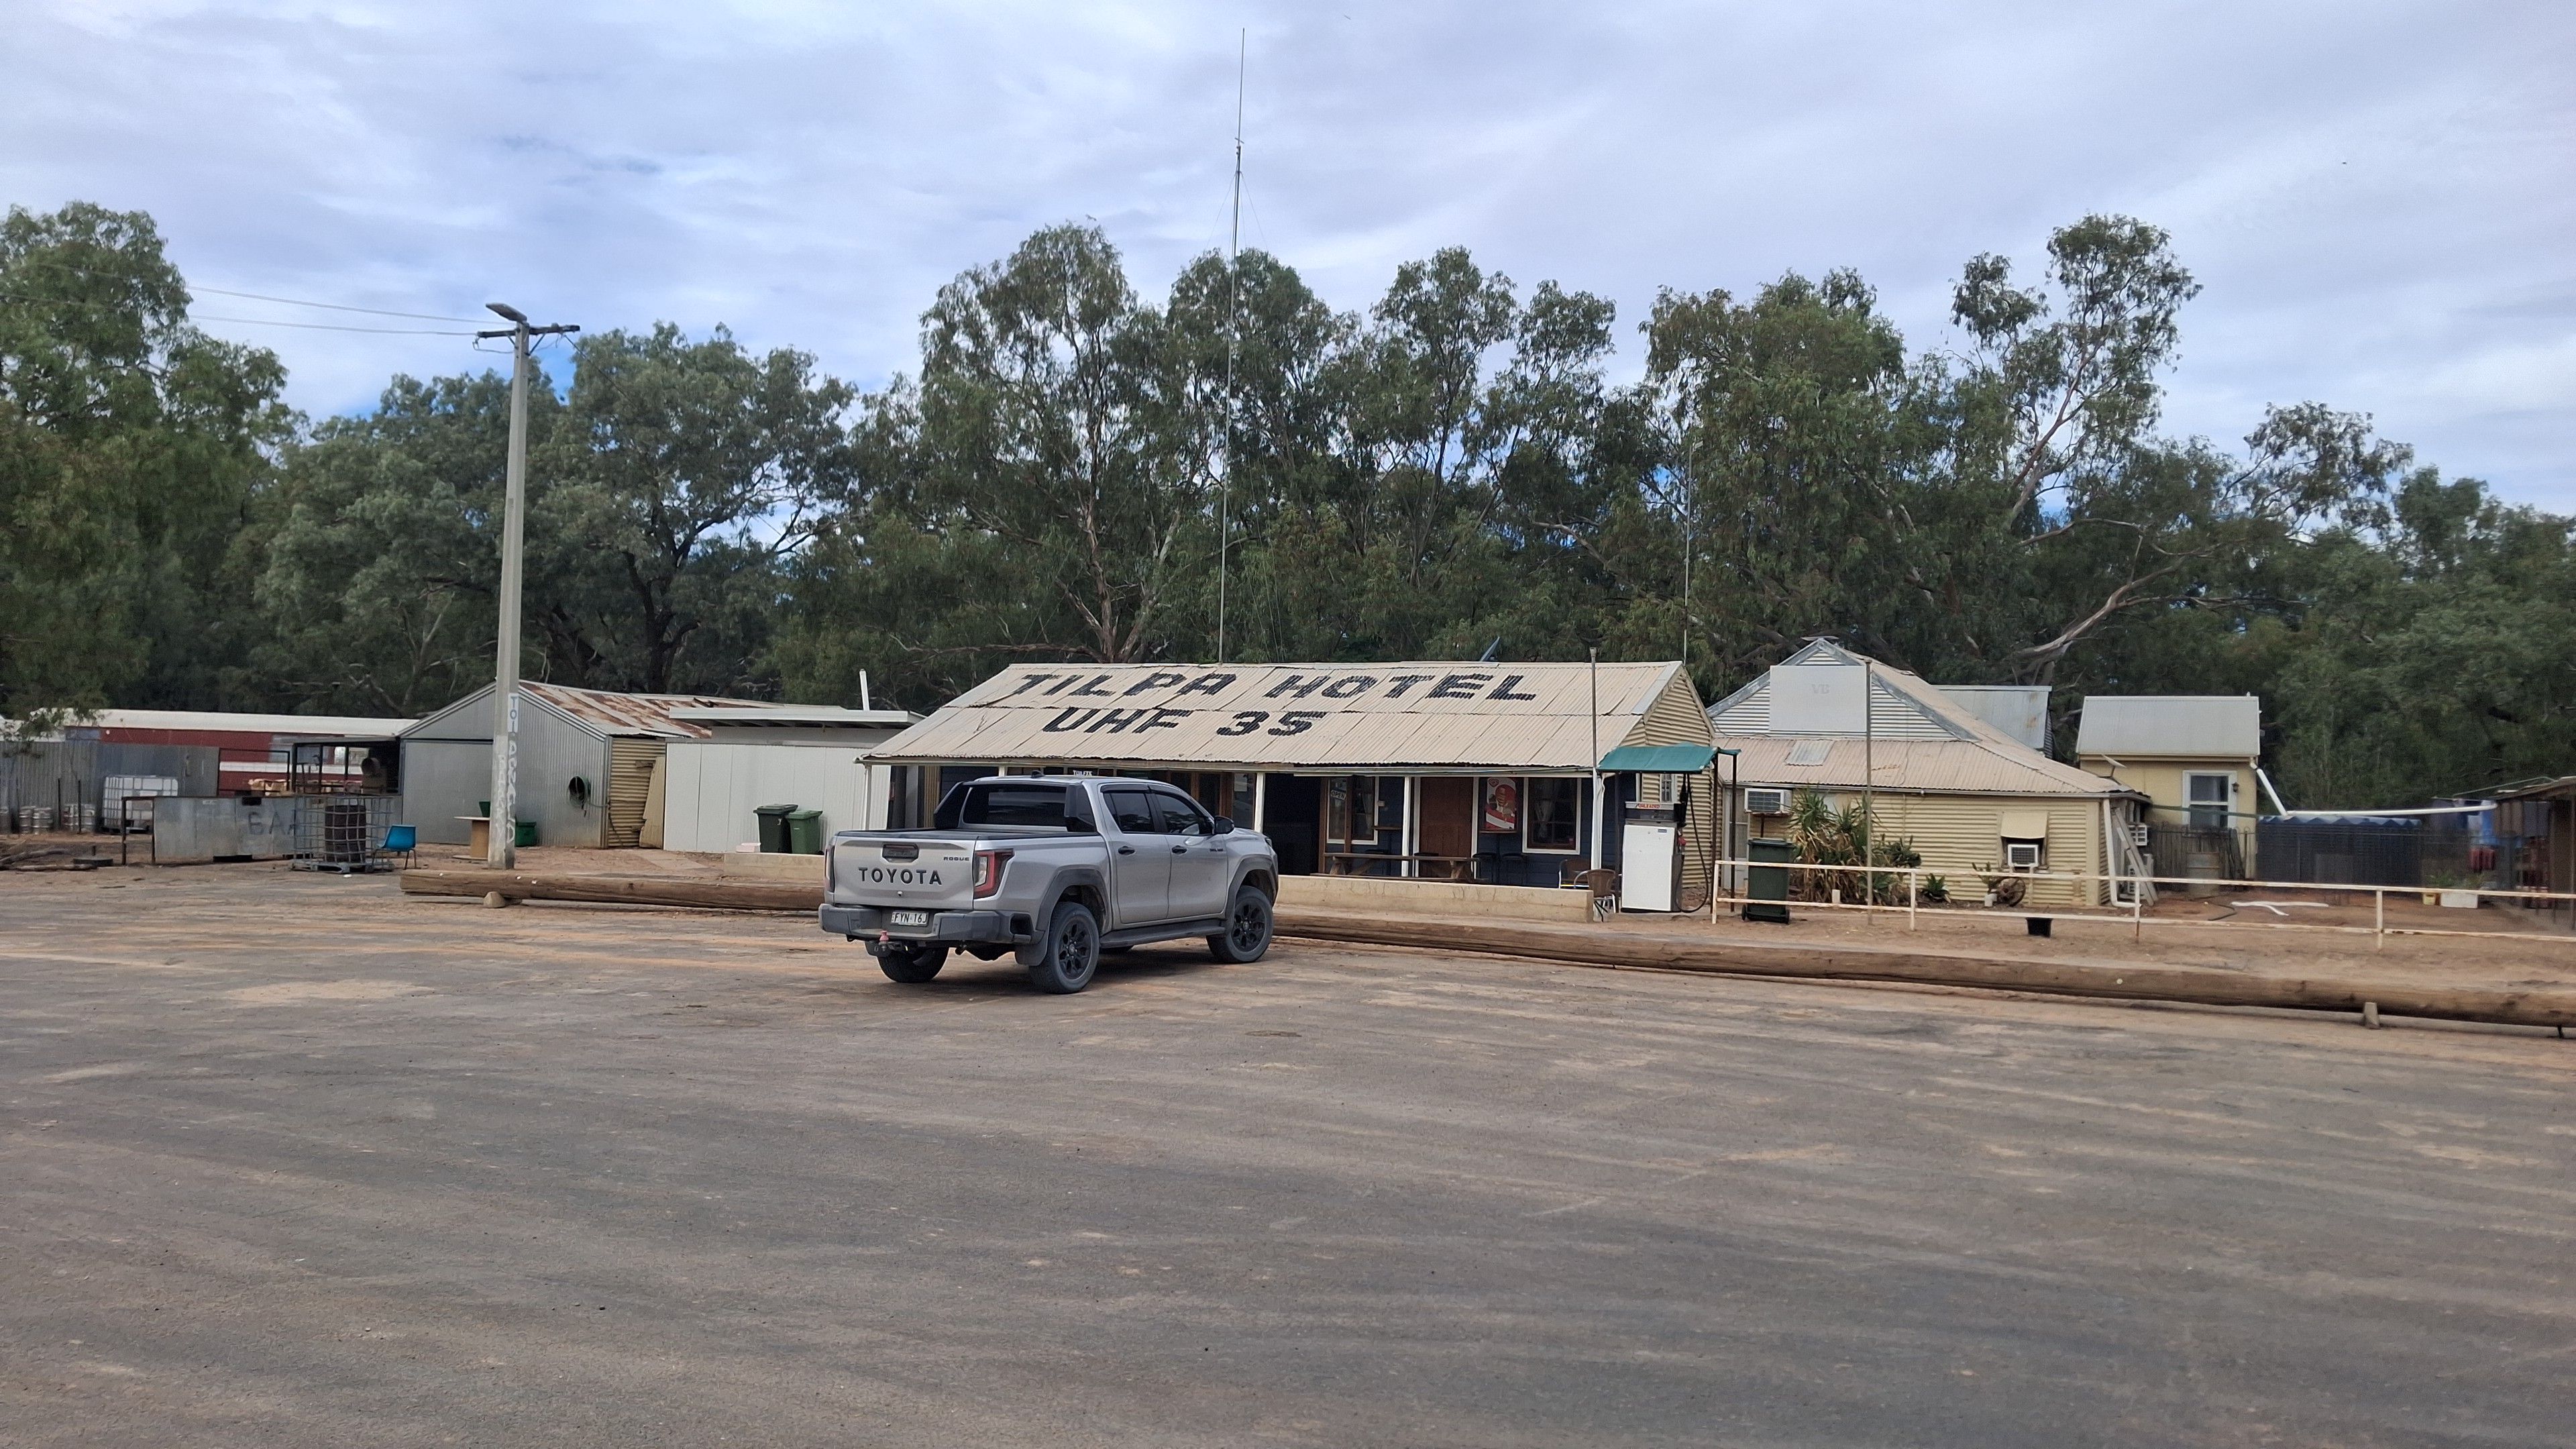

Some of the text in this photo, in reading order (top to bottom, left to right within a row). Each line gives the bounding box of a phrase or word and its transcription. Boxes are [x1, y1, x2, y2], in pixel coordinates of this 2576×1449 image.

[1013, 673, 1537, 701] TILPA HOTEL
[1042, 706, 1328, 737] UHF 35
[1331, 791, 1346, 799] OPEN
[859, 867, 943, 885] TOYOTA
[894, 913, 928, 923] FYN 16J
